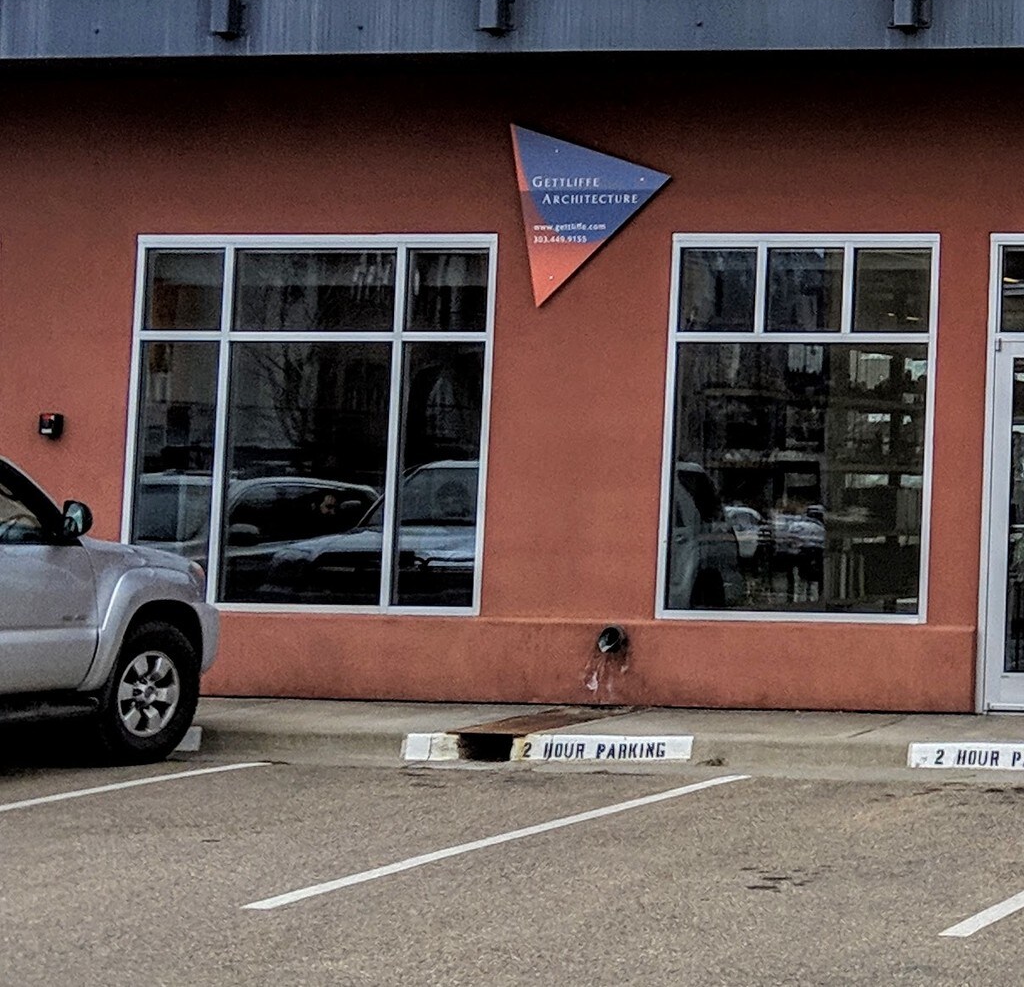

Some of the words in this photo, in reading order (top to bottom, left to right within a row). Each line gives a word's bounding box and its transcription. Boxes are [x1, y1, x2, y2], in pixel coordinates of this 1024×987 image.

[532, 176, 600, 188] GETTLIFFE
[542, 194, 638, 204] ARCHITECTURE
[522, 741, 533, 758] 2
[543, 741, 585, 760] HOUR
[596, 741, 667, 760] PARKING
[934, 749, 945, 765] 2
[956, 749, 1000, 767] HOUR
